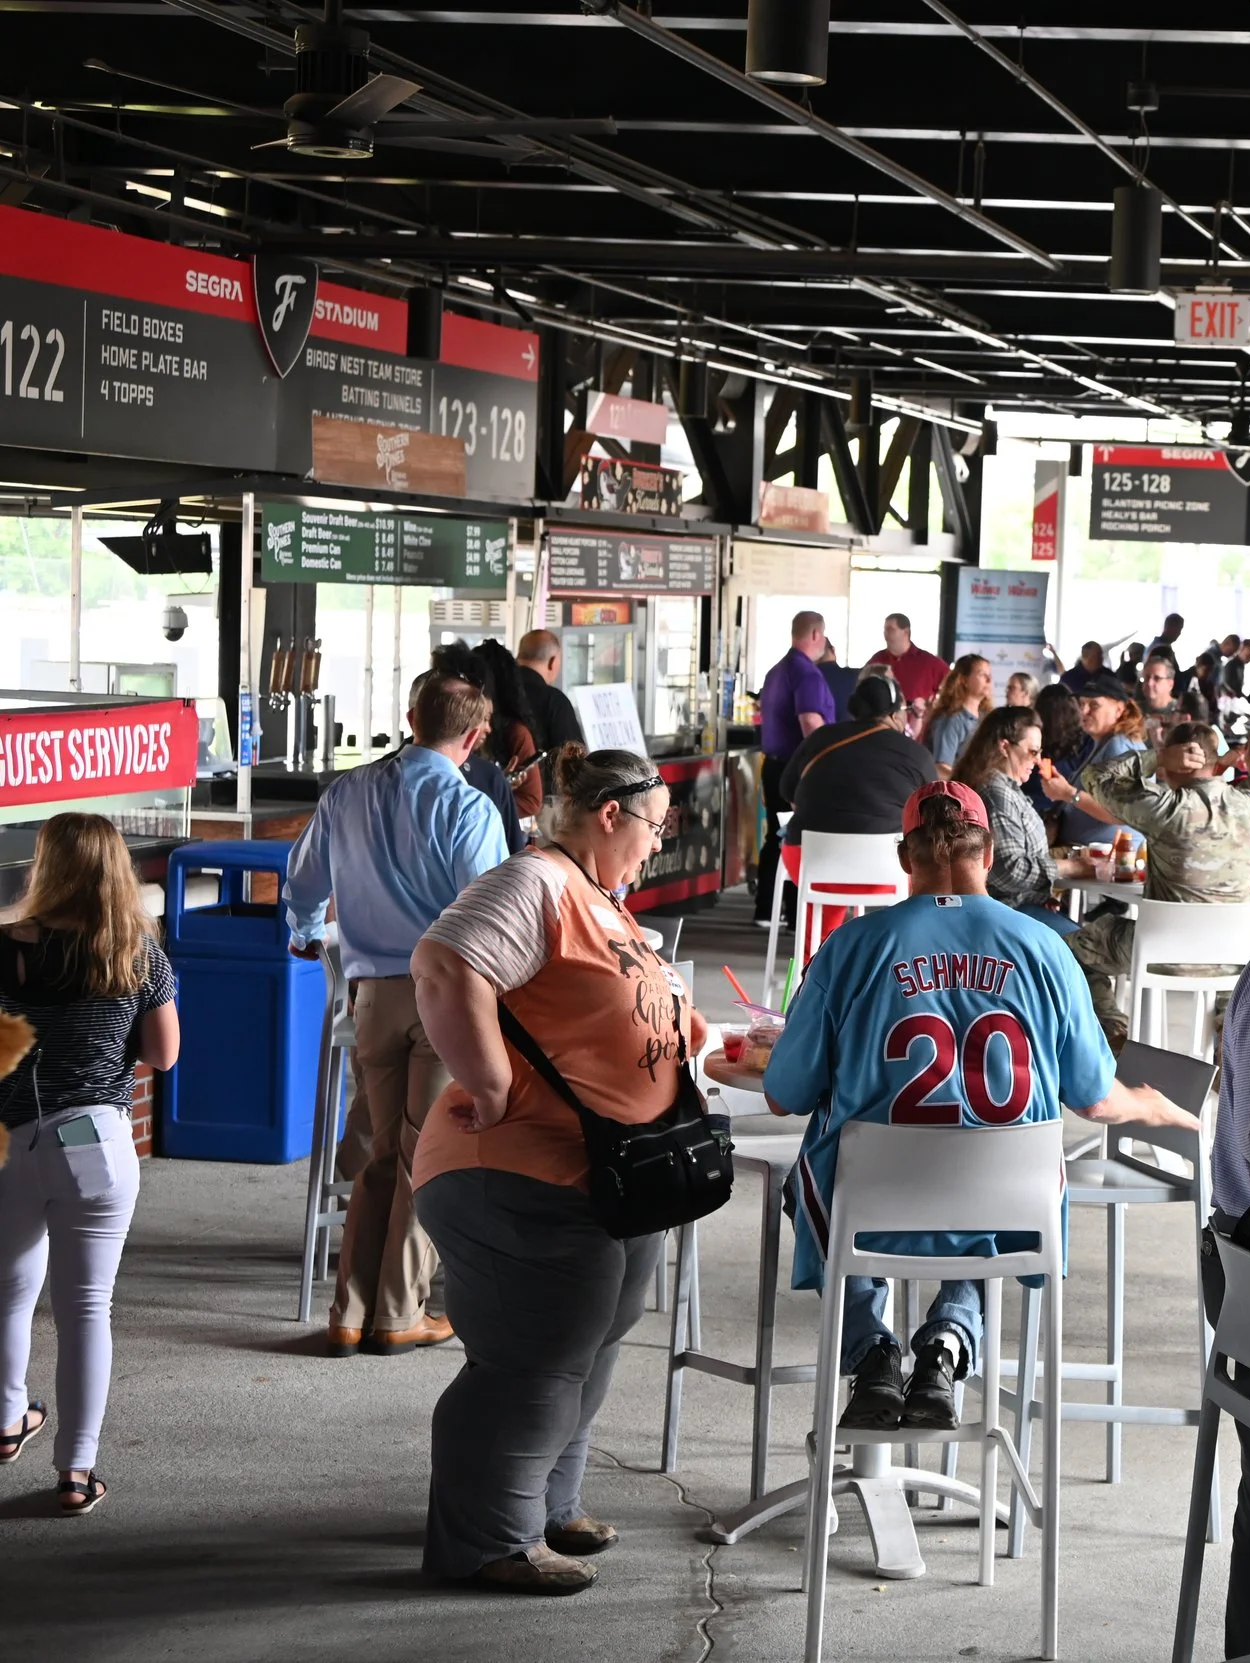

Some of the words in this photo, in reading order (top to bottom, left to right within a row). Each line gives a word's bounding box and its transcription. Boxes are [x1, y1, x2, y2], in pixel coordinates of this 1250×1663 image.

[185, 270, 244, 302] SEGRA
[102, 309, 139, 336] FIELD
[143, 317, 184, 343] BOXES
[315, 300, 380, 332] STADIUM
[1190, 300, 1239, 338] EXIT
[0, 320, 65, 403] 122
[101, 344, 138, 370] HOME
[142, 351, 180, 377] PLATE
[183, 358, 207, 381] BAR
[306, 348, 338, 371] BIRDS'
[340, 356, 366, 377] NEST
[367, 360, 393, 382] TEAM
[394, 367, 423, 387] STORE
[100, 380, 109, 401] 4
[113, 381, 154, 407] TOPPS
[341, 385, 380, 408] BATTING
[382, 392, 422, 415] TUNNELS
[439, 396, 527, 463] 123-128
[1161, 448, 1215, 461] SEGRA
[1103, 472, 1171, 494] 125-128
[302, 511, 329, 525] Souvenir
[329, 513, 343, 526] Draft
[344, 515, 358, 527] Beer
[1139, 512, 1158, 521] BAR
[1154, 500, 1184, 511] PICNIC
[1185, 501, 1210, 512] ZONE
[302, 526, 317, 539] Draft
[318, 527, 332, 540] Beer
[302, 541, 329, 554] Premium
[329, 543, 341, 555] Can
[302, 555, 329, 569] Domestic
[330, 558, 342, 570] Can
[1032, 542, 1054, 556] 125
[67, 722, 172, 781] SERVICES
[892, 952, 1015, 998] SCHMIDT
[884, 1010, 1033, 1127] 20
